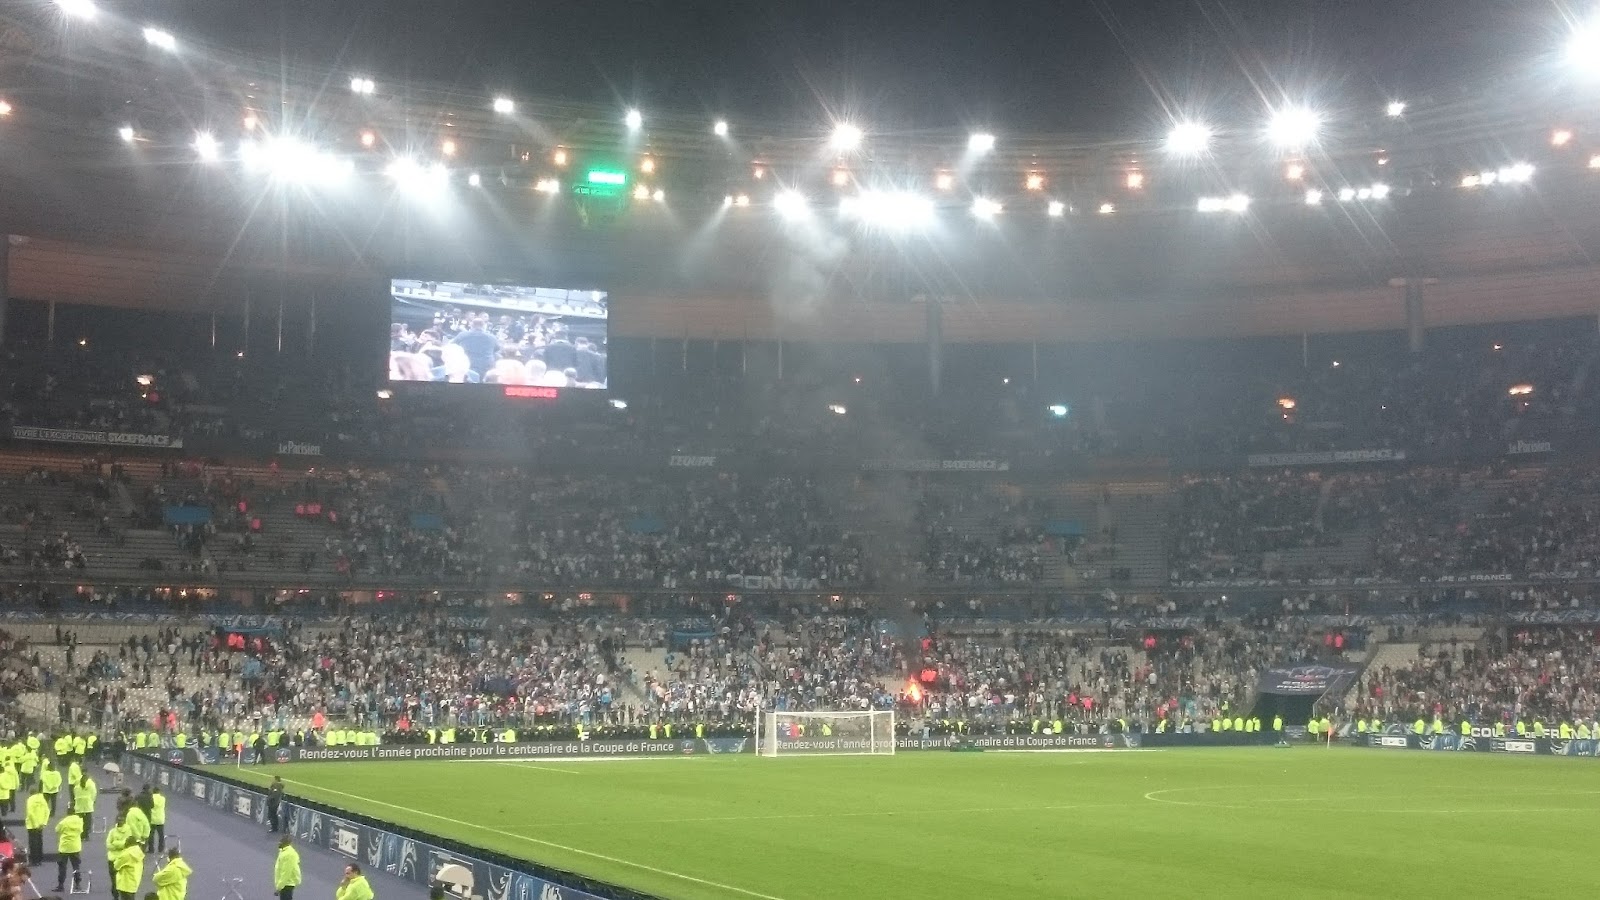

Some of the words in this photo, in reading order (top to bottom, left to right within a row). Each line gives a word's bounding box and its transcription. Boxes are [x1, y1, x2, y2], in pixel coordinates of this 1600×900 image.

[300, 749, 369, 759] Rendez-vous
[372, 746, 411, 757] l'année
[414, 746, 466, 758] prochaine
[469, 746, 494, 757] pour
[496, 744, 506, 755] le
[508, 743, 564, 754] centenaire
[566, 742, 578, 753] de
[580, 742, 590, 753] la
[593, 742, 624, 755] Coupe
[626, 741, 638, 752] de
[641, 742, 674, 752] France
[777, 739, 835, 749] Rendez-vous
[1004, 736, 1014, 746] de
[1016, 736, 1024, 746] la
[1026, 736, 1054, 748] Coupe
[1055, 736, 1066, 746] de
[1068, 736, 1097, 746] France
